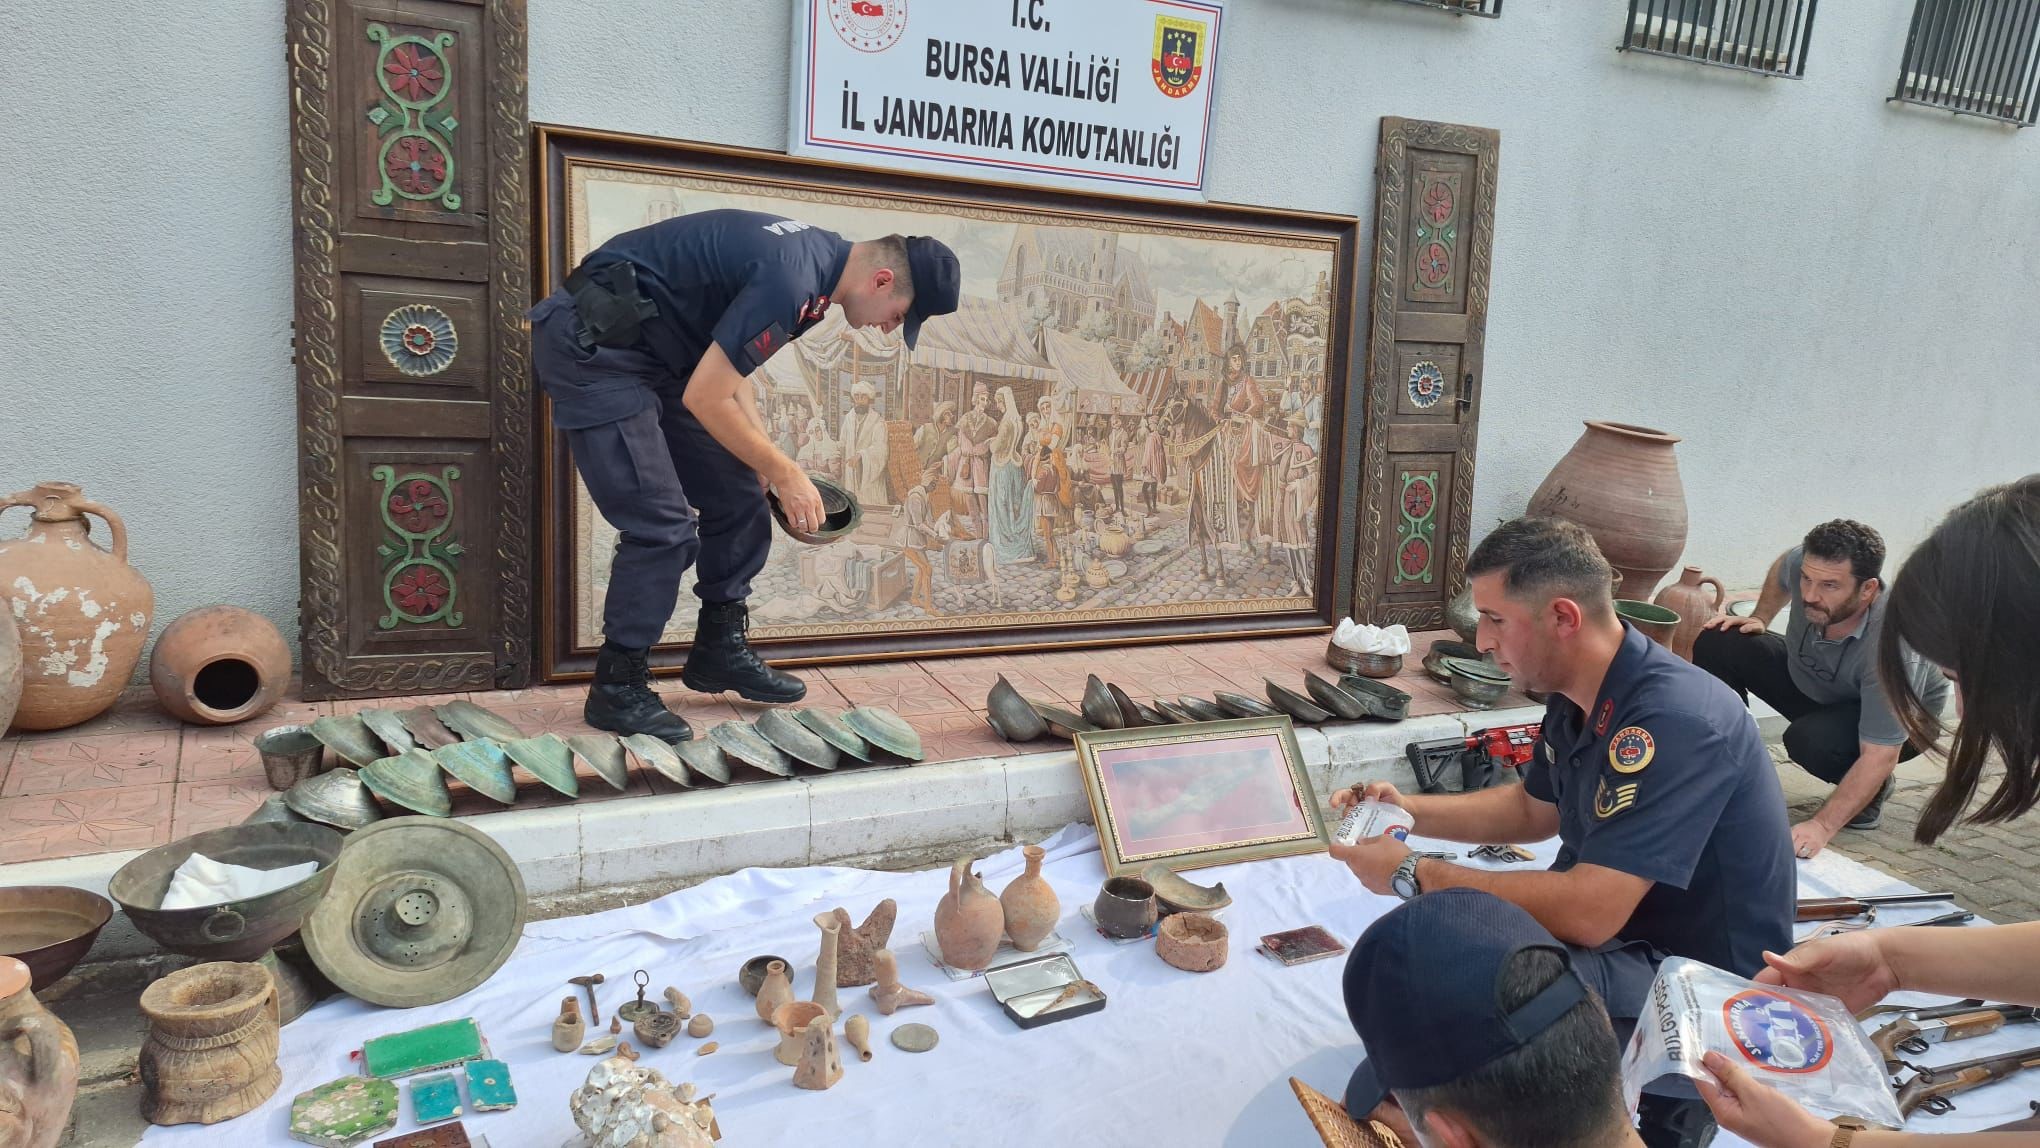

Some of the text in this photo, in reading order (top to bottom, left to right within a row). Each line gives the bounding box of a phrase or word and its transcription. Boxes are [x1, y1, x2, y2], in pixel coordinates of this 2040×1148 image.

[926, 39, 1120, 103] BURSA VALİLİĞİ
[1153, 68, 1199, 96] JANDARMA
[841, 81, 1180, 170] İL JANDARMA KOMUTANLIĞI
[1612, 728, 1651, 747] JANDARMA
[1660, 1012, 1682, 1061] BULGU
[1730, 1000, 1762, 1056] JANDARMA
